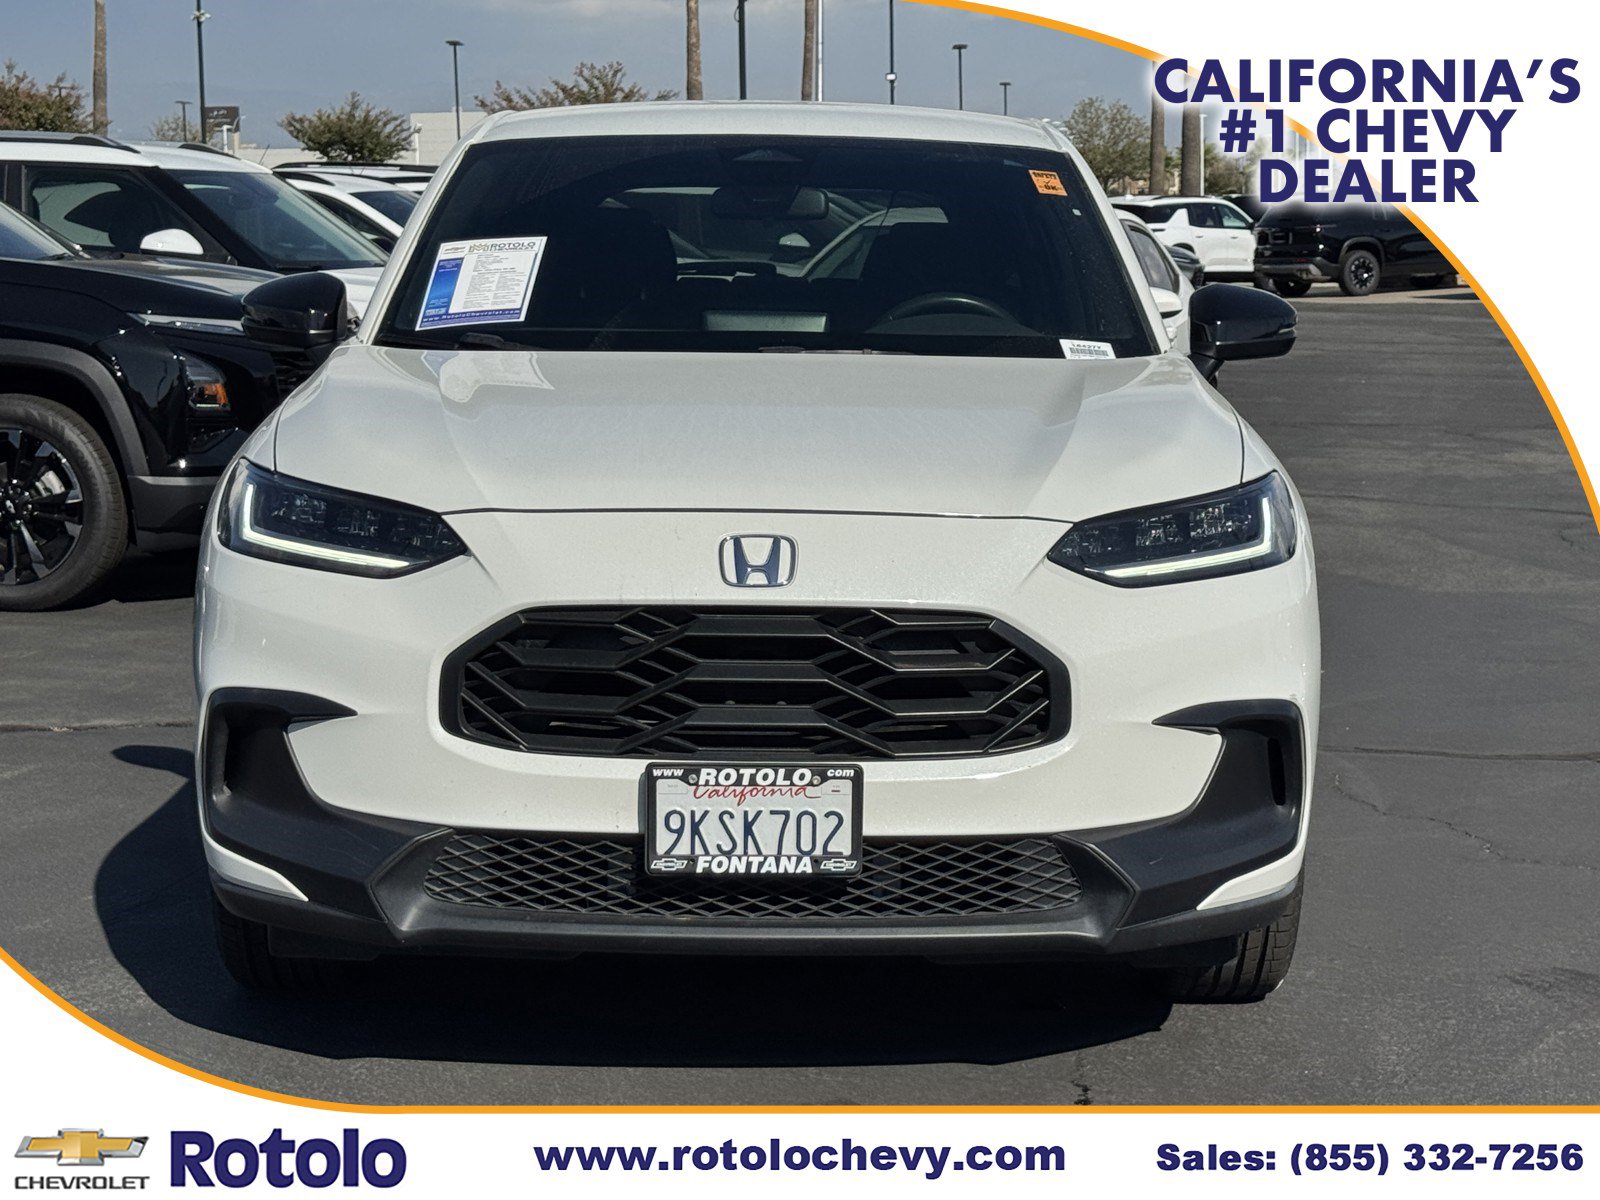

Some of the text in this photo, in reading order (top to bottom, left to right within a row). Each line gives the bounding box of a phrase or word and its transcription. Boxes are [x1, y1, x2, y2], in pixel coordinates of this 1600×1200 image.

[490, 241, 536, 251] ROTOLO
[653, 768, 855, 786] www ROTOLO com
[693, 785, 822, 807] California
[663, 808, 845, 856] 9KSK702
[695, 856, 814, 874] FONTANA
